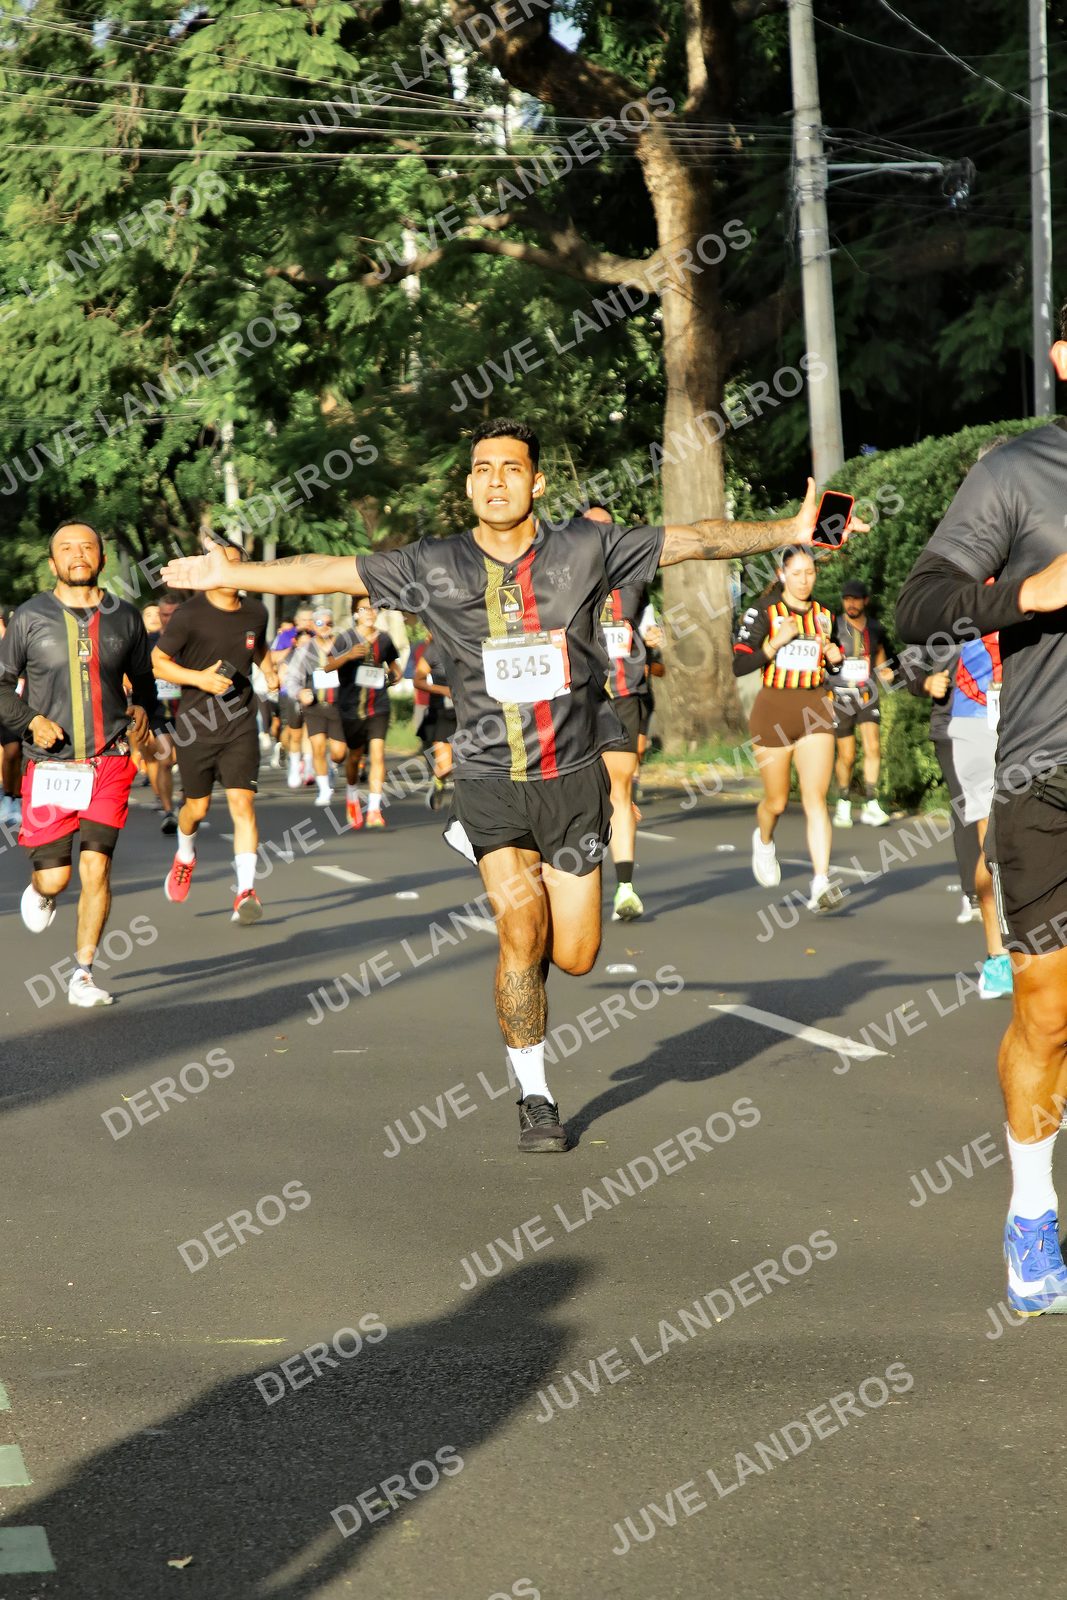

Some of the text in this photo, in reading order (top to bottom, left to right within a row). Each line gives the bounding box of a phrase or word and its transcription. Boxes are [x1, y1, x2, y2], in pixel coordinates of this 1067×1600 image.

[784, 644, 817, 656] 12150
[496, 654, 551, 680] 8545
[46, 777, 81, 791] 1017
